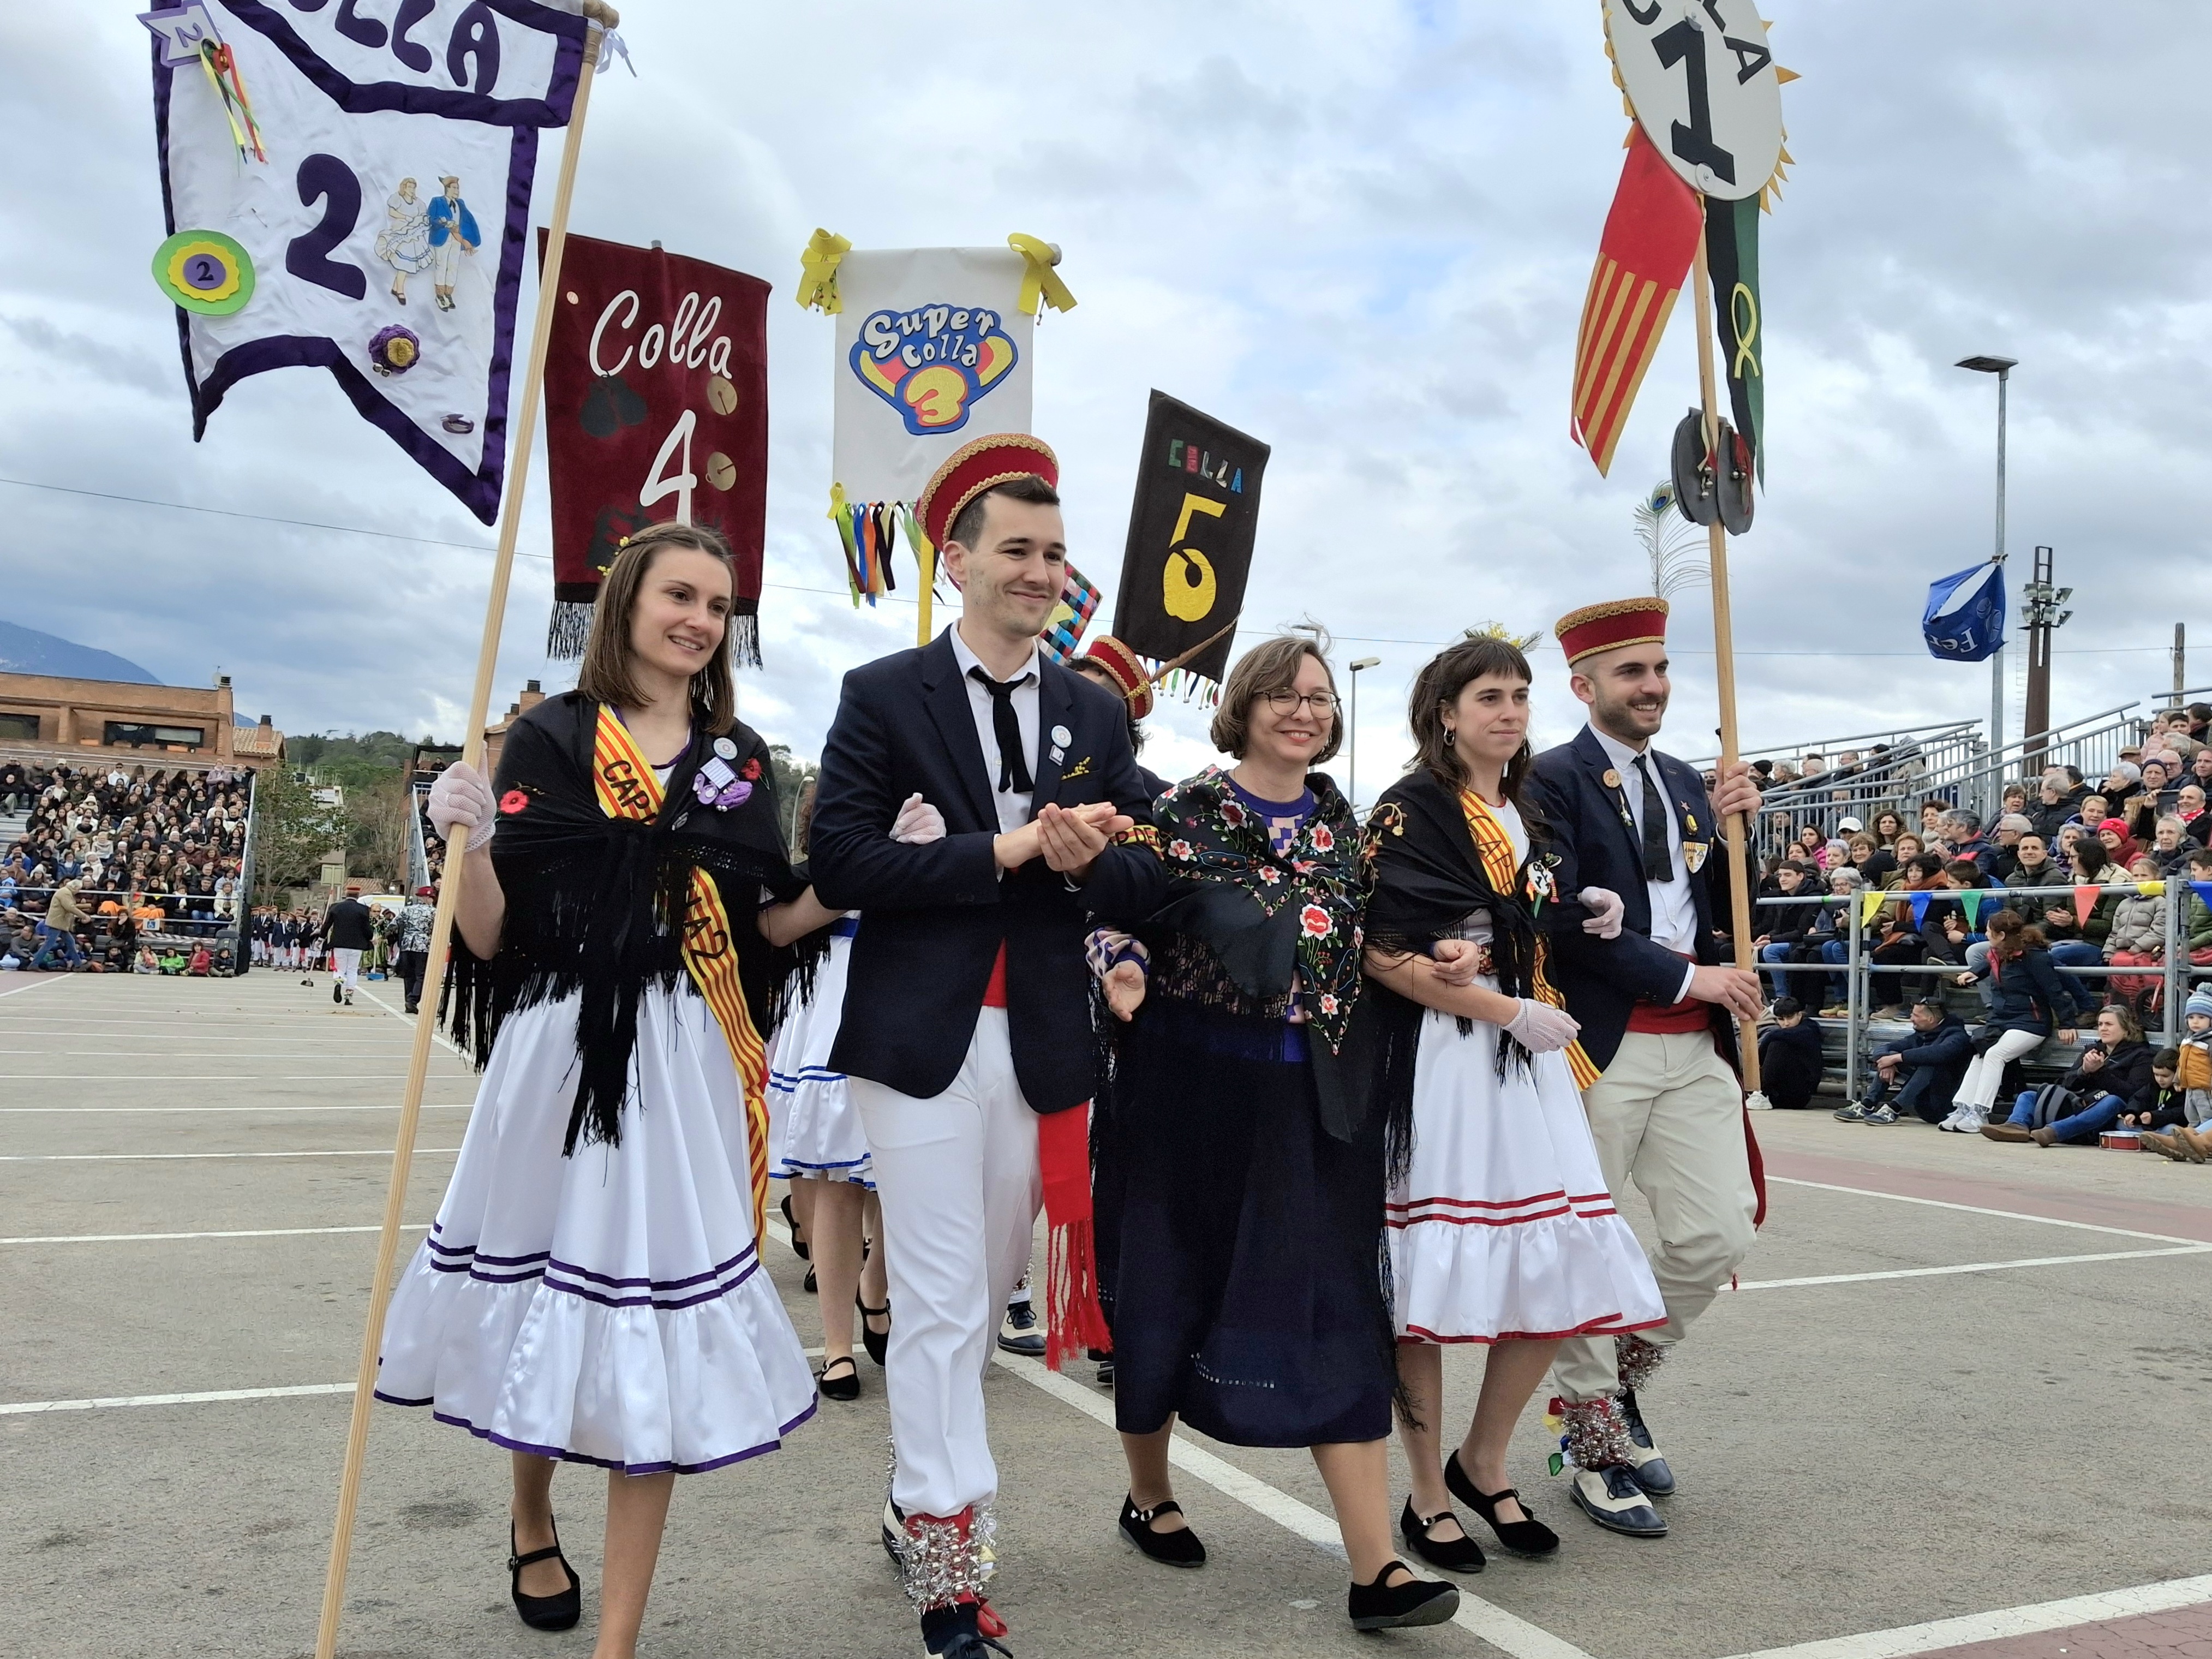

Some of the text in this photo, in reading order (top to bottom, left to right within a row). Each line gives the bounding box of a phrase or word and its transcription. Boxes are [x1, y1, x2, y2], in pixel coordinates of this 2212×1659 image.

[175, 22, 204, 47] 2
[1651, 20, 1736, 186] 1
[285, 153, 367, 300] 2
[196, 261, 214, 282] 2
[589, 290, 732, 379] Colla
[864, 307, 995, 359] Super
[901, 333, 978, 368] colla
[904, 365, 969, 427] 3
[639, 409, 697, 528] 4
[1168, 439, 1242, 494] COLLA
[603, 760, 650, 809] CAP
[1469, 815, 1512, 867] CAP
[690, 930, 728, 978] 2
